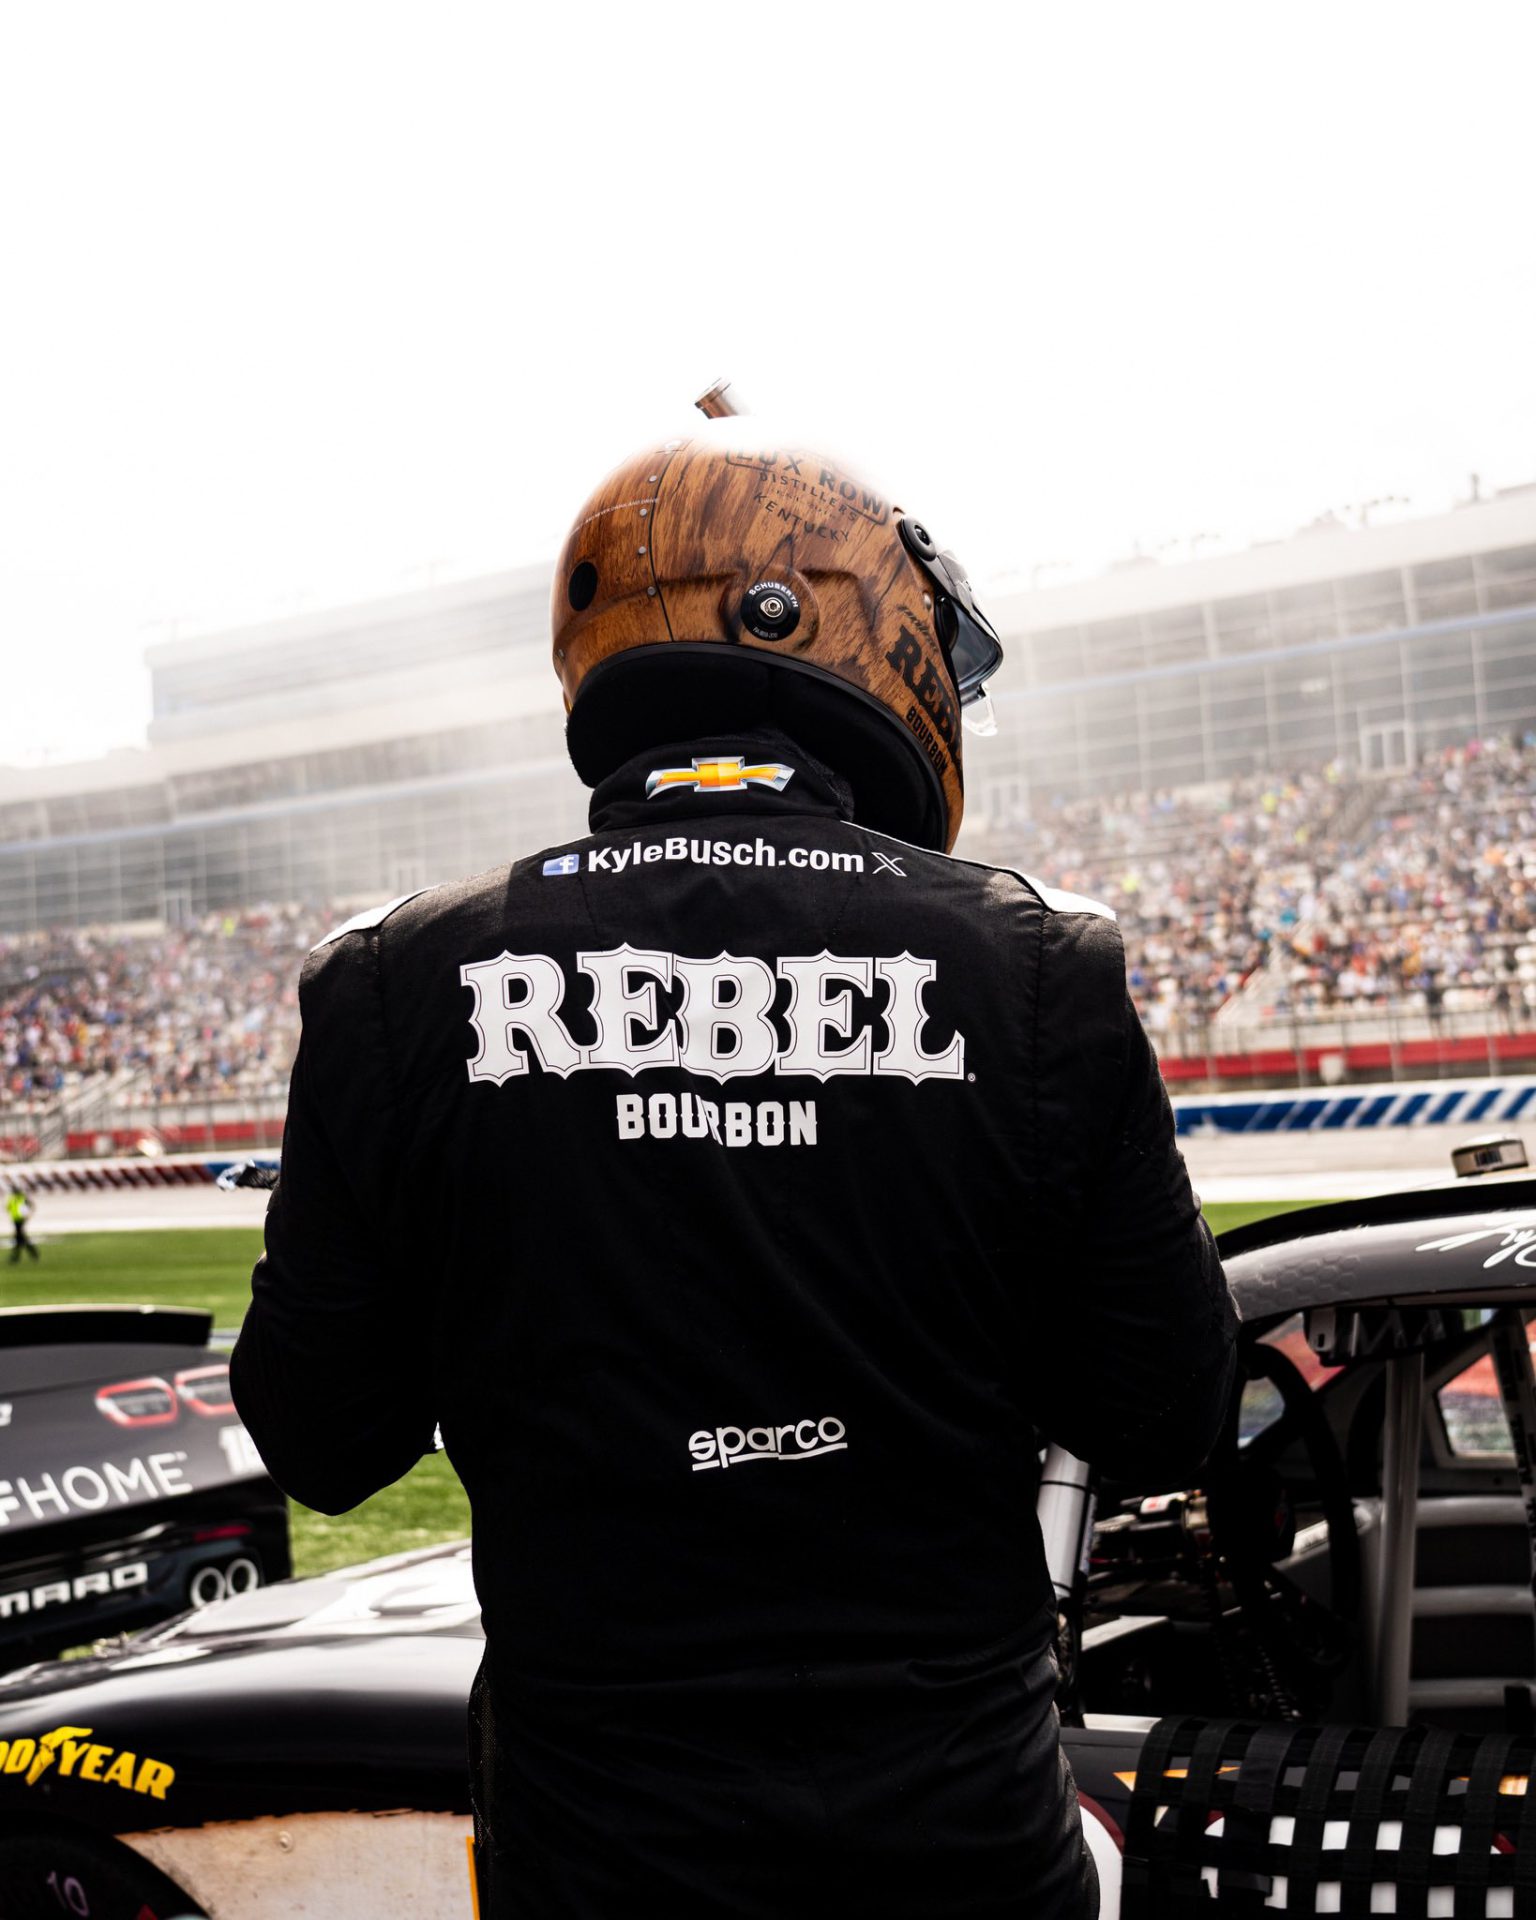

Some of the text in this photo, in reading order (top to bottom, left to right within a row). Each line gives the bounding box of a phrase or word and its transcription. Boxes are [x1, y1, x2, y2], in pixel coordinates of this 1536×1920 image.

[759, 472, 858, 522] DISTILLERS
[818, 467, 883, 516] ROW
[753, 492, 850, 542] KENTUCKY
[749, 582, 799, 608] SCHUBERTH
[588, 837, 865, 873] KyleBusch.com
[459, 942, 966, 1087] REBEL
[616, 1092, 818, 1147] BOURBON
[688, 1416, 846, 1471] sparco
